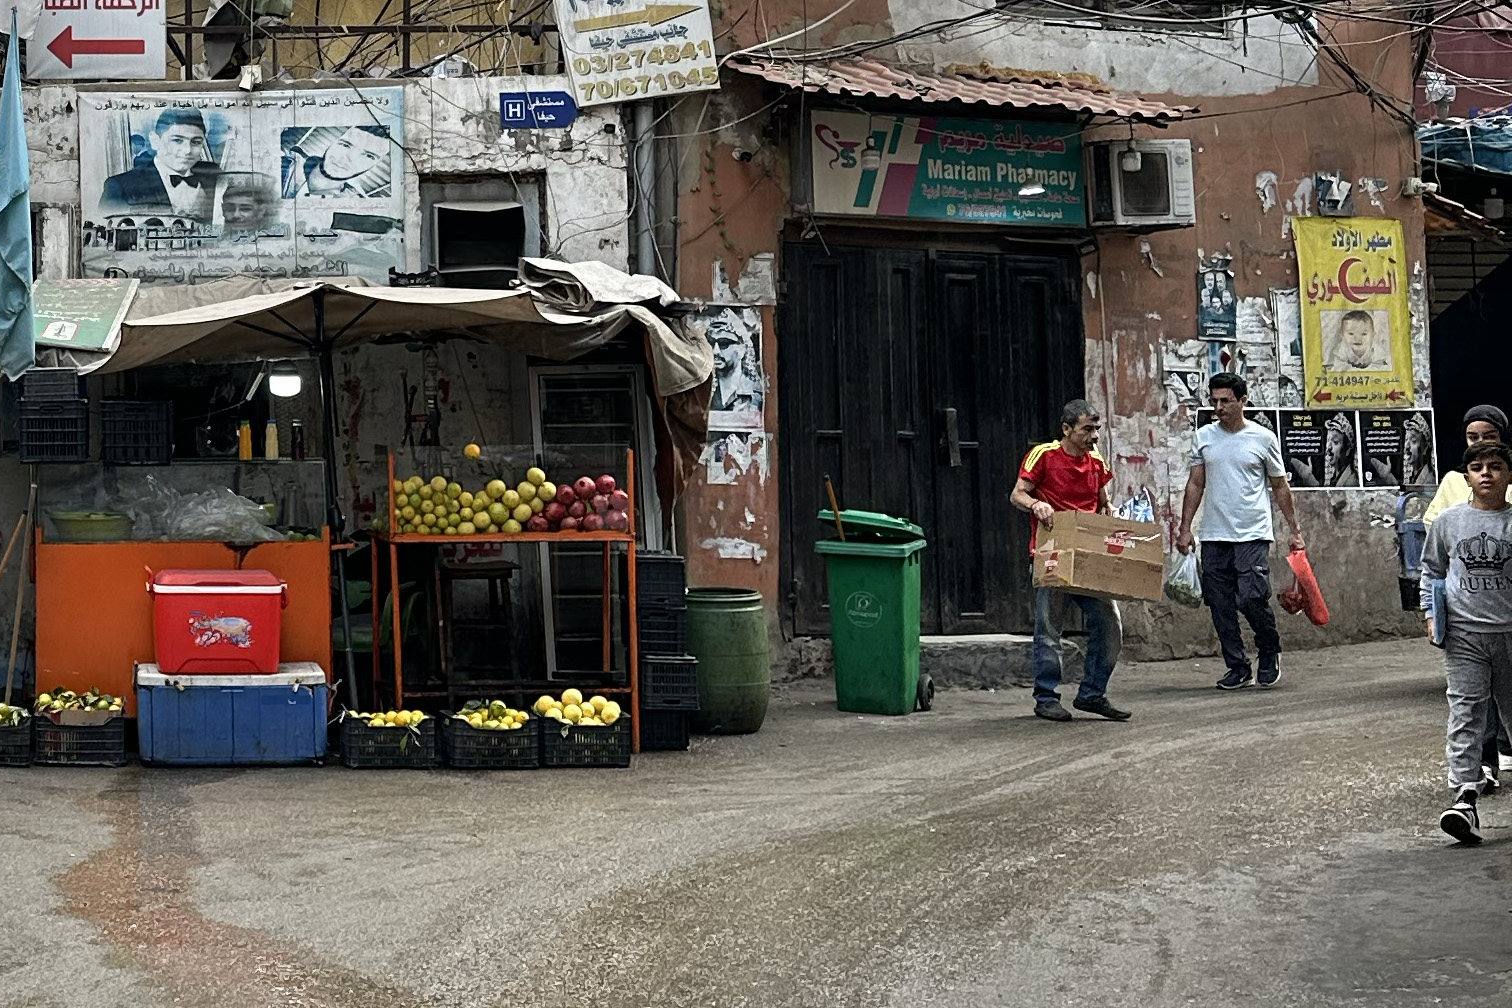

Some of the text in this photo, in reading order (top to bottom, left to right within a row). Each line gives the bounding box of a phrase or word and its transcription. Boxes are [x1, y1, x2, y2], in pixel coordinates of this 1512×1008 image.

[573, 40, 712, 75] 03/274841
[579, 66, 719, 101] 70/671045
[508, 103, 521, 118] H
[939, 124, 1066, 156] صيدلية مريم
[927, 159, 1077, 191] Mariam Phamacy
[1364, 231, 1393, 252] مطهر
